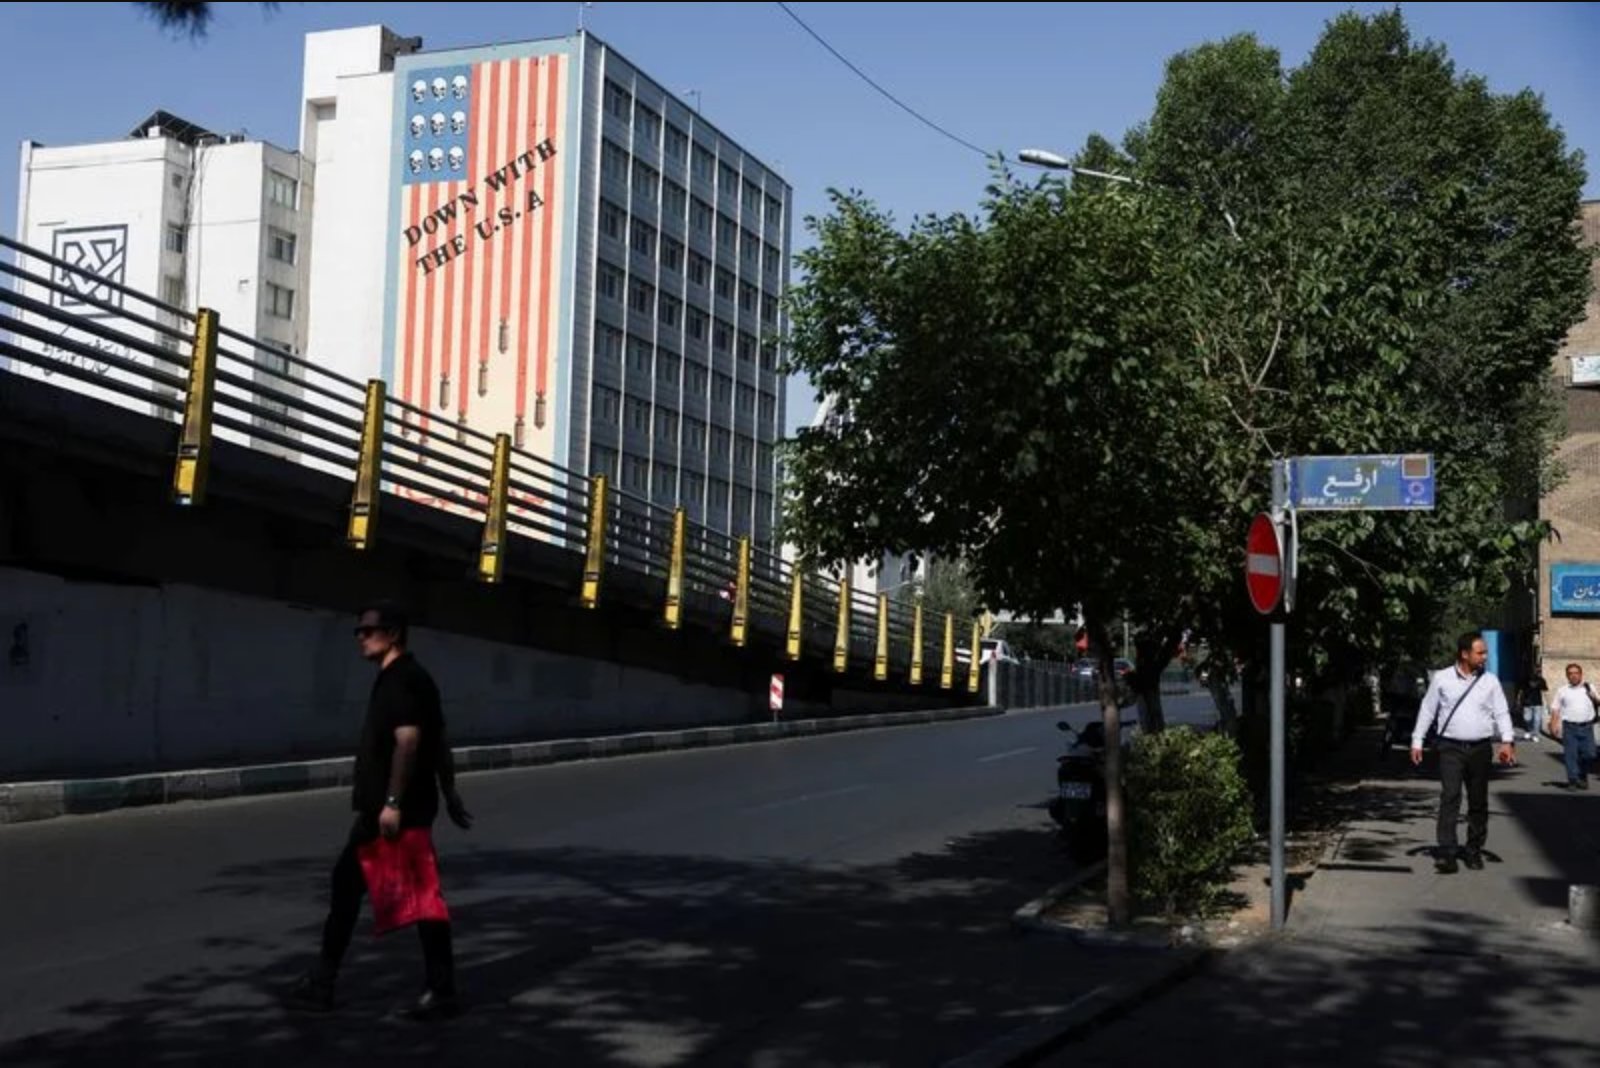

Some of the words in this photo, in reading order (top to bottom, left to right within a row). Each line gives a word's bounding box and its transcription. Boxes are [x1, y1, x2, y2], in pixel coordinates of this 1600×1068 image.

[403, 188, 479, 248] DOWN
[484, 138, 557, 192] WITH
[415, 233, 468, 276] THE
[1323, 468, 1377, 497] ارفع
